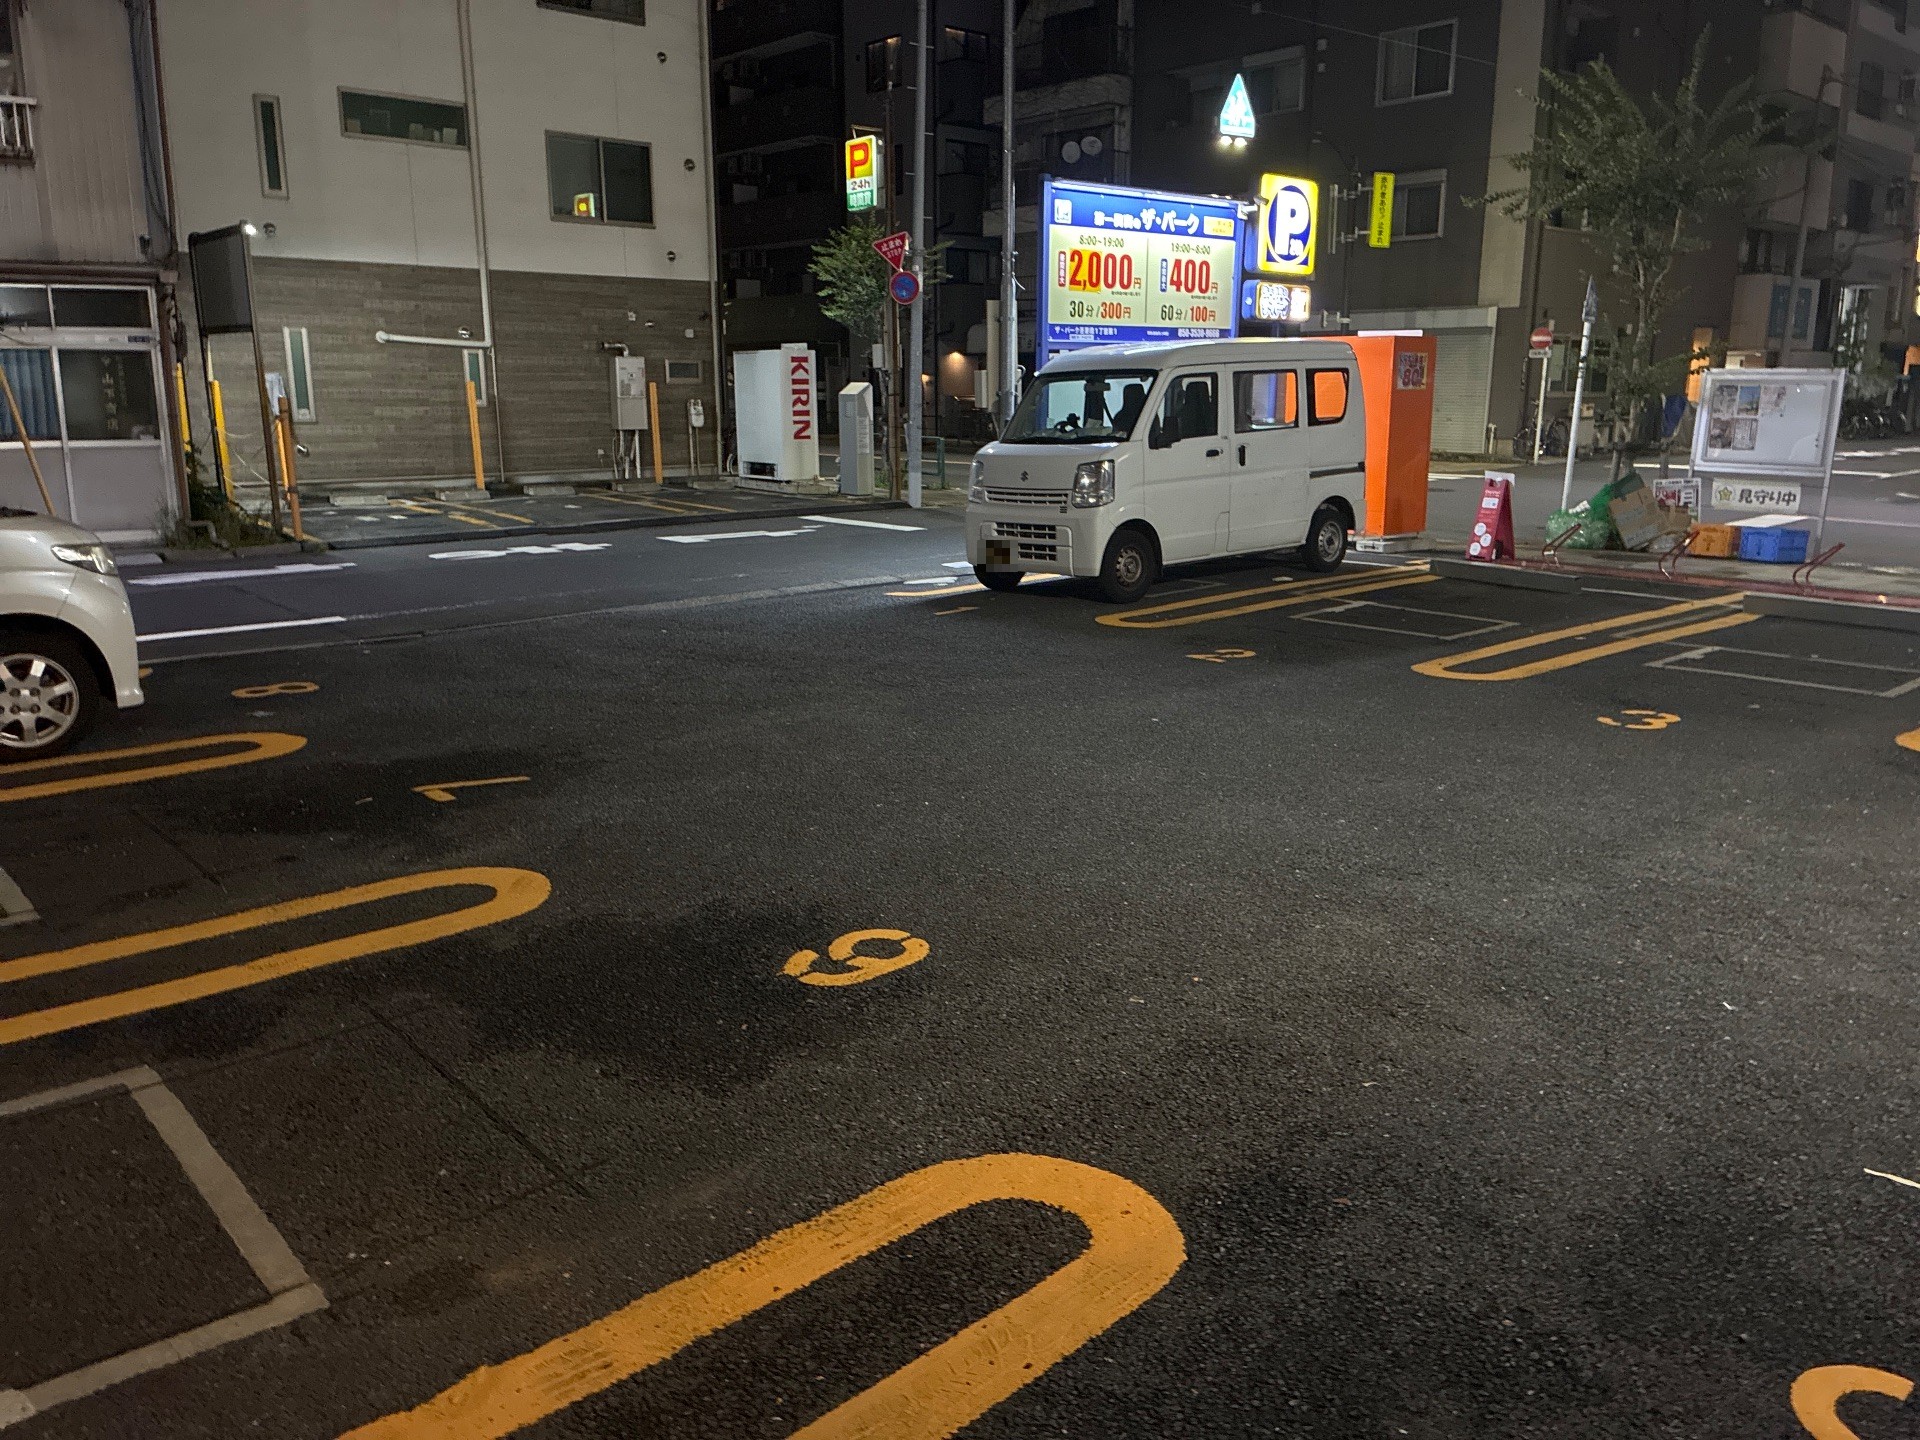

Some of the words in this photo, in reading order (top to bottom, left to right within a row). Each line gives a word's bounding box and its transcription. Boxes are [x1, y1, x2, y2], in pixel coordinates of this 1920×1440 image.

[850, 142, 869, 179] P
[851, 178, 871, 191] 24h
[1274, 189, 1310, 256] P
[791, 356, 811, 440] KIRIN
[1738, 487, 1797, 507] 見守り中
[1596, 709, 1681, 730] 3
